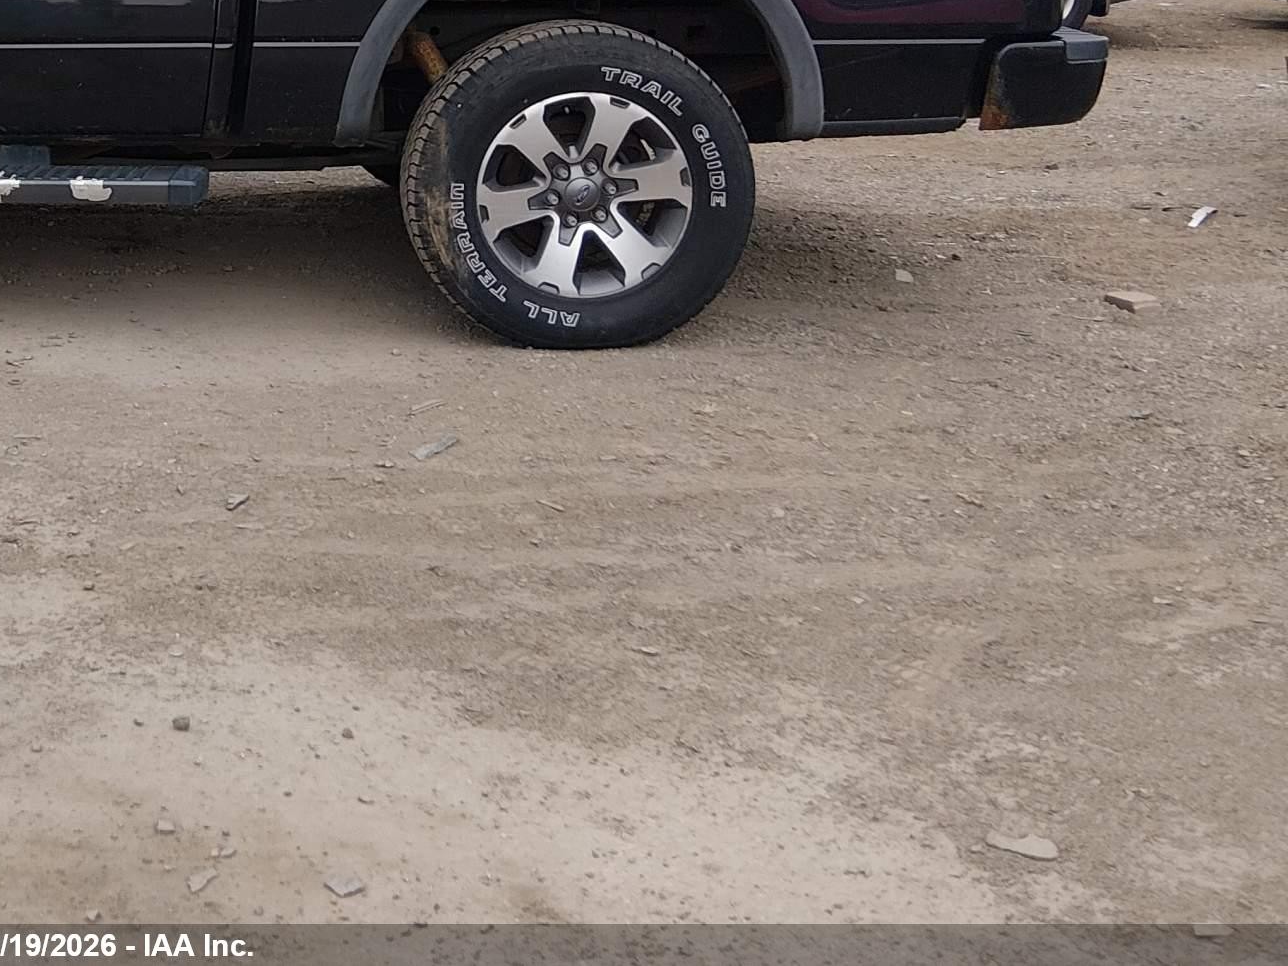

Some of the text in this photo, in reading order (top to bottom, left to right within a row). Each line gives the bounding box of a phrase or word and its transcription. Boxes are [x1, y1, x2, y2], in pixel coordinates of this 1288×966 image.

[601, 65, 726, 208] TRAIL GUIDE
[450, 183, 580, 328] ALL TERRAIN
